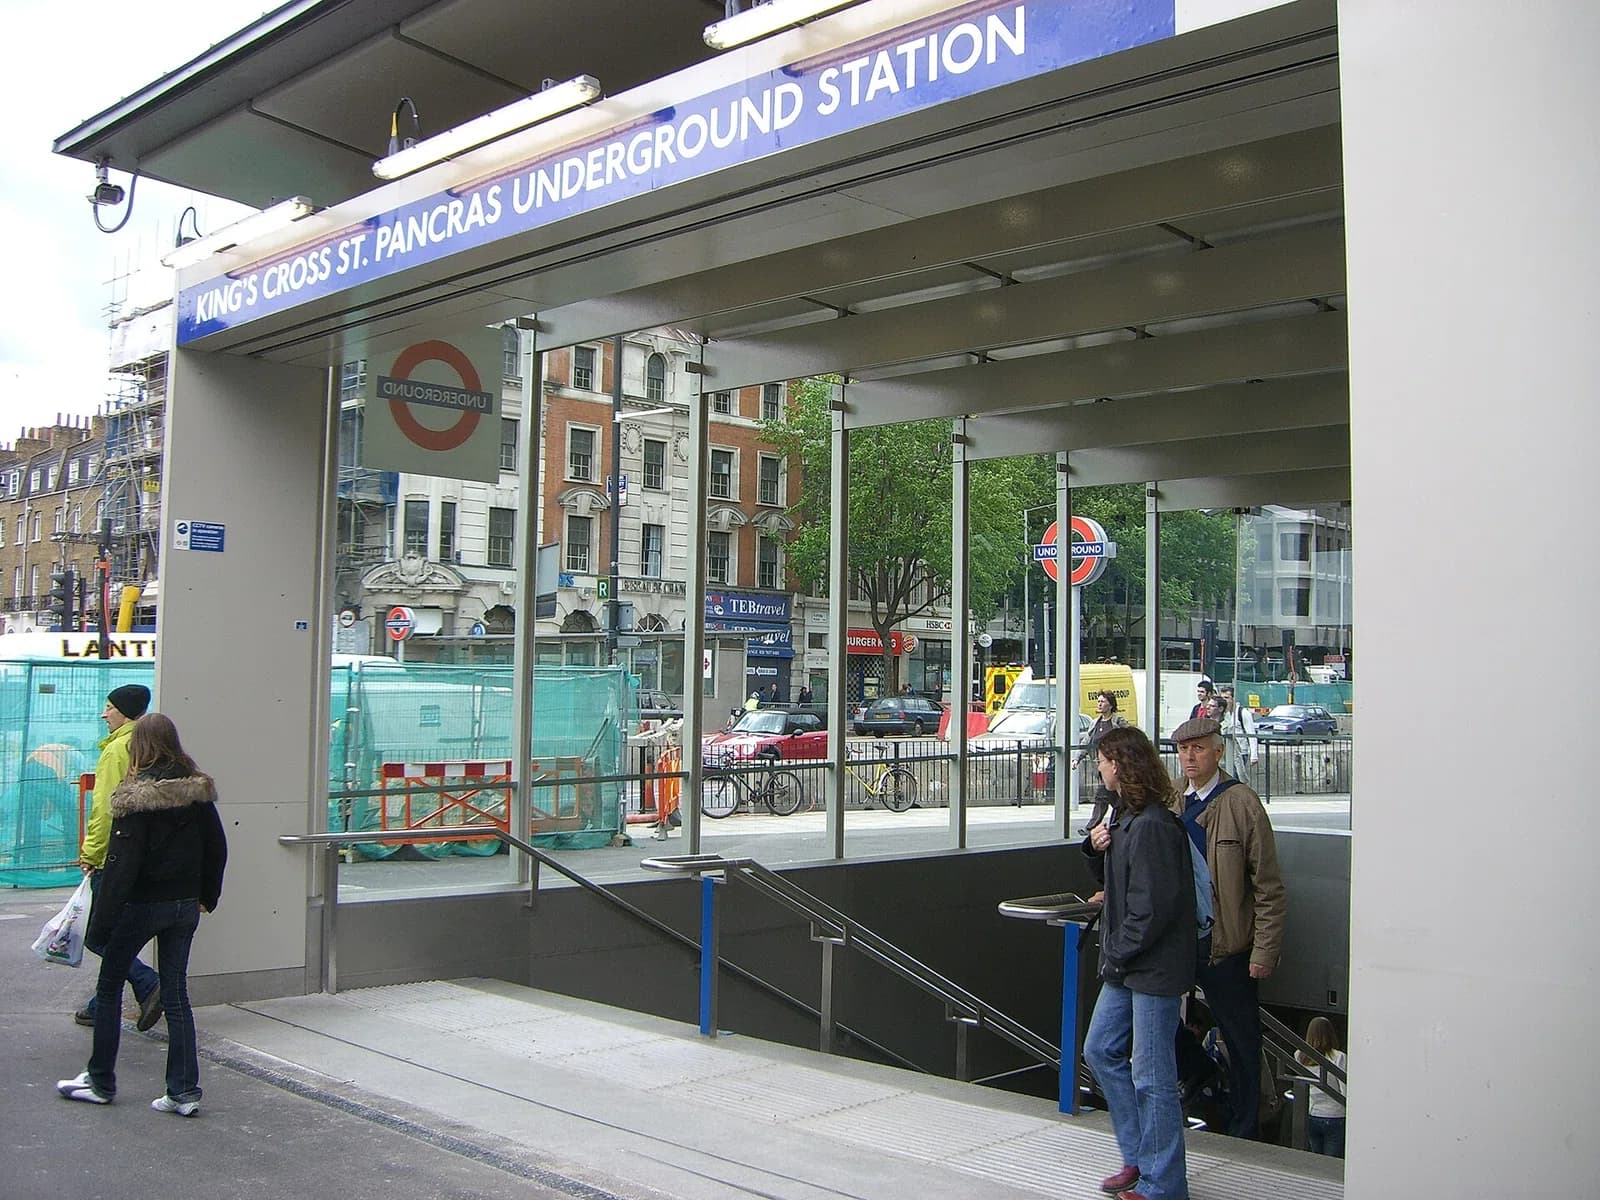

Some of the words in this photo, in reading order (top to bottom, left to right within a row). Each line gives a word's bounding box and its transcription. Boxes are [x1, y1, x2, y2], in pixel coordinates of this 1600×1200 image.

[196, 272, 257, 325] KING'S
[262, 246, 331, 299] CROSS
[336, 235, 368, 275] ST.
[375, 185, 501, 262] PANCRAS
[512, 83, 803, 214] UNDERGROUND
[816, 5, 1025, 115] STATION
[1038, 545, 1101, 556] UNDROUND
[599, 582, 607, 596] R
[730, 599, 785, 616] TEBtravel
[926, 620, 944, 629] HSBC
[878, 638, 897, 648] KG
